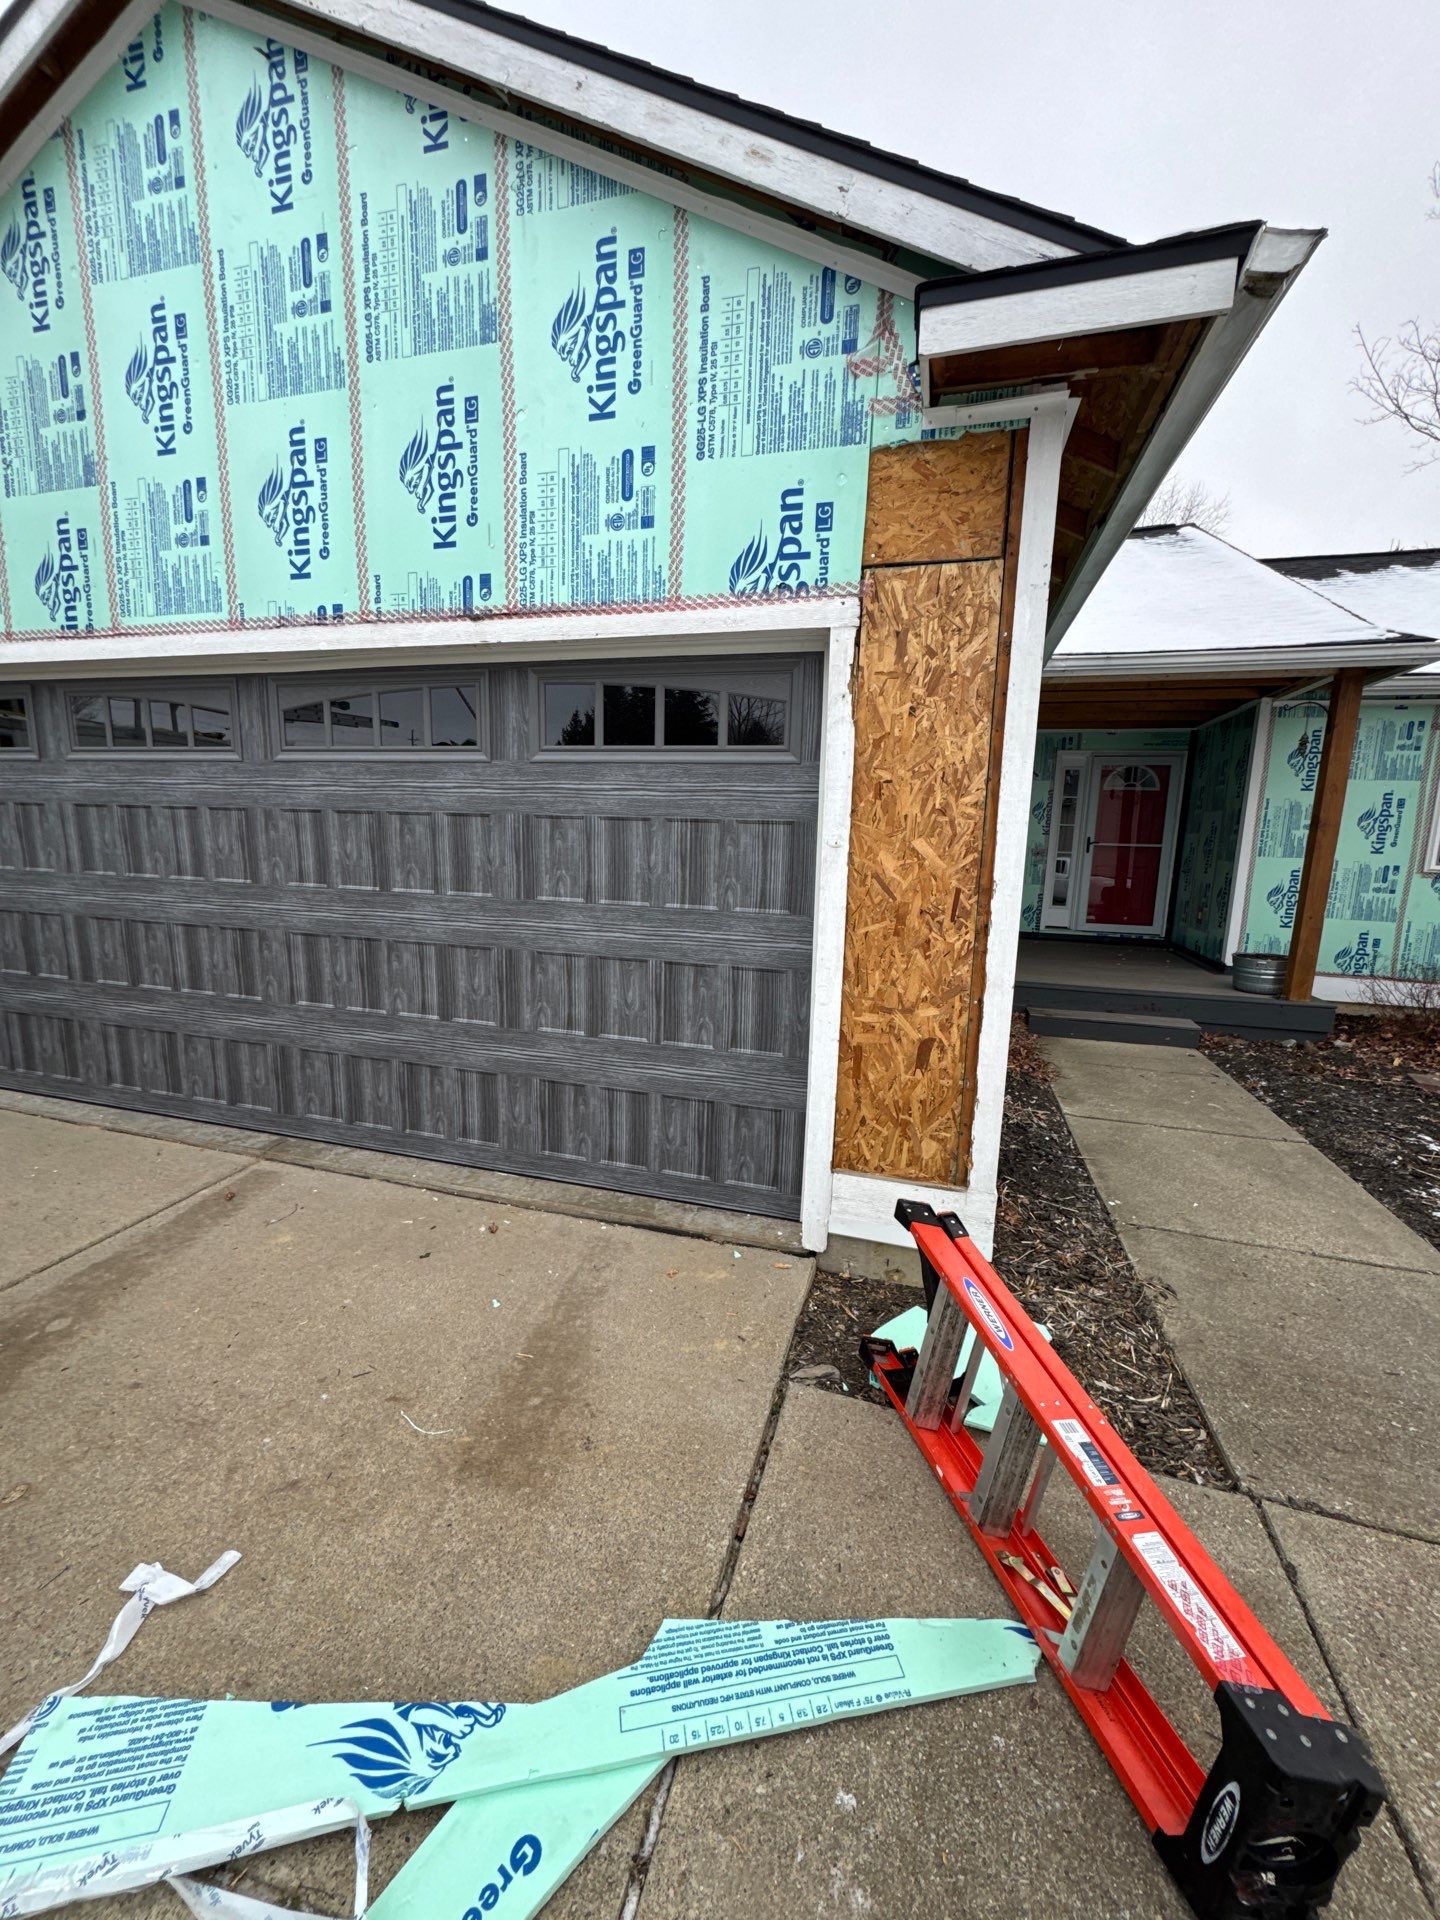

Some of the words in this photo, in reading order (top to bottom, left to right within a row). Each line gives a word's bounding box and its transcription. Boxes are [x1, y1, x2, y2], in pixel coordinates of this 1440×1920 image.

[266, 38, 297, 215] Kingspan
[298, 78, 313, 185] GreenGuard
[515, 140, 524, 158] XP
[44, 187, 56, 213] LG
[359, 192, 368, 228] Board
[21, 178, 50, 333] Kingspan
[48, 217, 65, 310] GreenGuard
[217, 248, 226, 281] Board
[361, 229, 370, 284] Insulation
[628, 247, 645, 280] LG
[363, 284, 372, 310] XPS
[373, 291, 382, 311] Type
[700, 275, 711, 313] Board
[220, 283, 229, 333] Insulation
[175, 313, 188, 340] LG
[587, 235, 626, 422] Kingspan
[223, 335, 231, 358] XPS
[365, 313, 374, 364] GG25-LG
[628, 284, 645, 396] GreenGuard
[699, 316, 710, 374] Insulation
[711, 341, 719, 356] PSI
[710, 356, 718, 368] 25
[150, 302, 179, 457] Kingspan
[225, 359, 234, 406] GG25-LG
[698, 374, 707, 403] XPS
[178, 344, 193, 435] GreenGuard
[709, 381, 718, 403] Type
[464, 396, 479, 424] LG
[708, 404, 717, 432] C578,
[696, 404, 706, 461] GG25-LG
[314, 437, 328, 464] LG
[707, 433, 716, 460] ASTM
[431, 383, 464, 550] Kingspan
[518, 452, 527, 485] Board
[466, 428, 478, 528] GreenGuard
[110, 481, 118, 509] Board
[287, 424, 316, 580] Kingspan
[318, 467, 330, 560] GreenGuard
[518, 488, 527, 539] Insulation
[815, 502, 834, 532] LG
[77, 527, 88, 551] LG
[113, 510, 122, 554] Insulation
[519, 541, 527, 565] XPS
[56, 517, 81, 632] ingspan
[118, 577, 126, 618] GG25-LG
[1300, 729, 1322, 792] Kingspan
[1370, 792, 1394, 855] Kingspan
[1279, 869, 1300, 929] Kingspan
[972, 1291, 1003, 1333] WERNER
[802, 1630, 826, 1640] product
[827, 1626, 848, 1635] current
[849, 1624, 864, 1632] most
[774, 1637, 789, 1645] code
[790, 1634, 802, 1642] and
[825, 1640, 839, 1650] tall.
[840, 1638, 866, 1647] stories
[867, 1636, 874, 1644] 6
[874, 1633, 891, 1643] over
[753, 1648, 791, 1662] Kingspan
[792, 1644, 823, 1657] Contact
[808, 1653, 820, 1664] not
[822, 1652, 829, 1661] is
[830, 1650, 847, 1660] XPS
[848, 1642, 894, 1657] GreenGuard
[700, 1660, 738, 1674] approved
[738, 1657, 752, 1667] for
[749, 1656, 806, 1675] recommended
[647, 1667, 698, 1683] applications.
[683, 1676, 700, 1688] wall
[701, 1671, 734, 1684] exterior
[735, 1667, 747, 1678] for
[813, 1674, 831, 1685] SOLD,
[832, 1670, 856, 1681] WHERE
[630, 1680, 682, 1697] applications
[735, 1690, 755, 1700] STATE
[756, 1687, 773, 1697] WITH
[774, 1679, 811, 1692] COMPLIANT
[672, 1696, 718, 1712] REGULATIONS
[720, 1693, 734, 1702] HFC
[734, 1721, 744, 1731] 10
[669, 1733, 679, 1744] 20
[136, 1760, 158, 1770] most
[159, 1756, 172, 1765] the
[174, 1754, 188, 1763] For
[71, 1769, 105, 1783] product
[105, 1764, 135, 1777] current
[147, 1775, 156, 1785] 6
[157, 1771, 182, 1782] over
[31, 1781, 54, 1791] code
[53, 1777, 71, 1787] and
[90, 1784, 109, 1796] tall.
[110, 1778, 146, 1792] stories
[41, 1788, 86, 1803] Contact
[110, 1784, 177, 1806] GreenGuard
[51, 1806, 72, 1818] not
[84, 1798, 108, 1812] XPS
[66, 1825, 99, 1837] WHERE
[1207, 1794, 1235, 1853] WERNER
[39, 1831, 66, 1845] SOLD,
[226, 1829, 263, 1861] Tyvek
[77, 1852, 118, 1887] Tyvek
